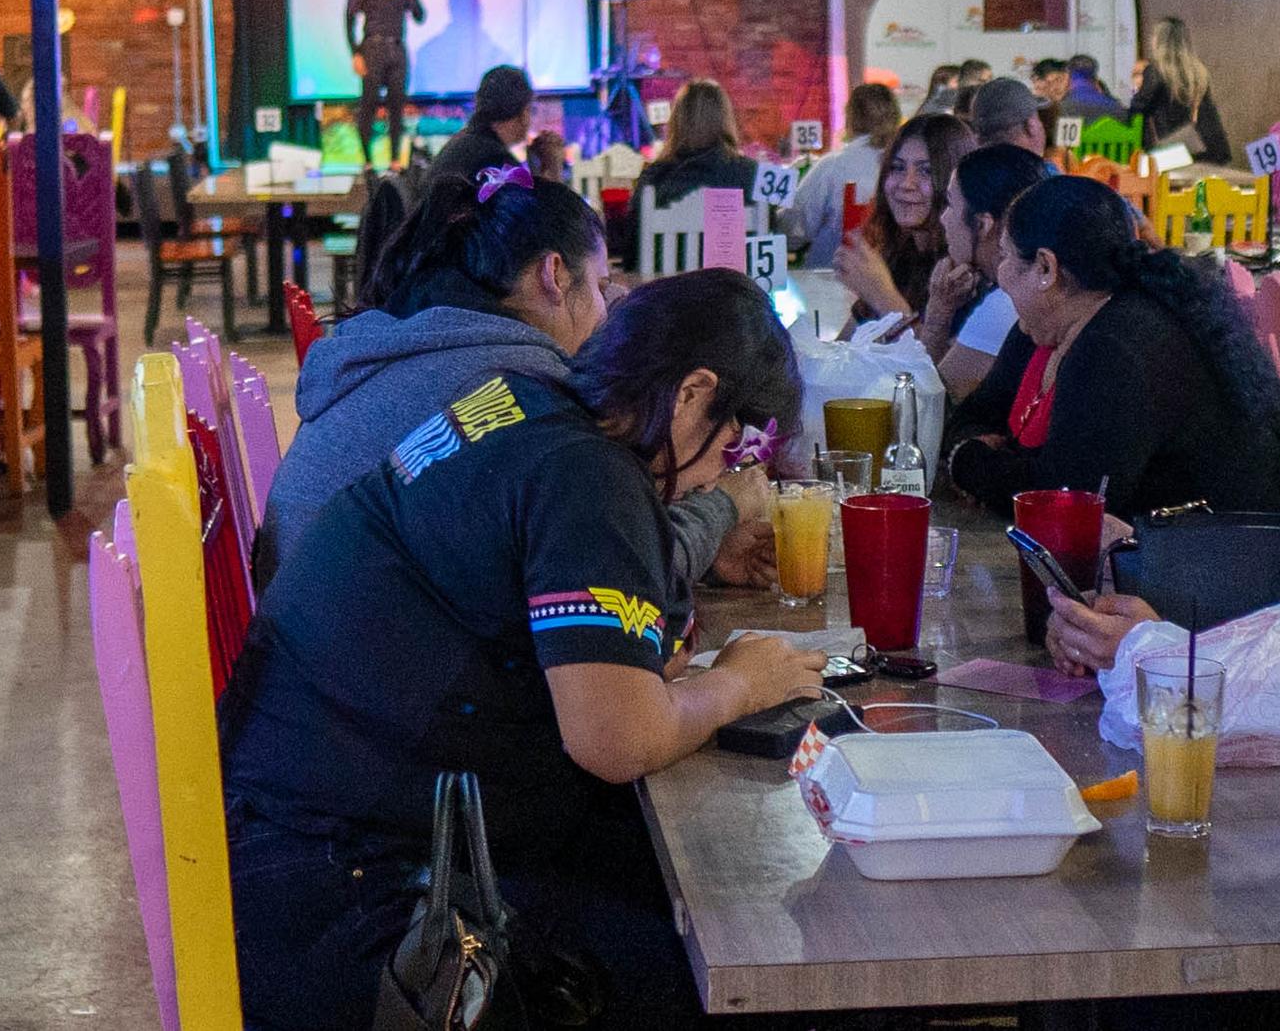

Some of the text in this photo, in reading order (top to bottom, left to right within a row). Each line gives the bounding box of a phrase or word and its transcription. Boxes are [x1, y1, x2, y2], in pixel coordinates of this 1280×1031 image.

[797, 125, 817, 145] 35
[1063, 124, 1078, 143] 10
[1253, 142, 1277, 170] 19
[761, 170, 791, 200] 34
[746, 240, 774, 277] 15
